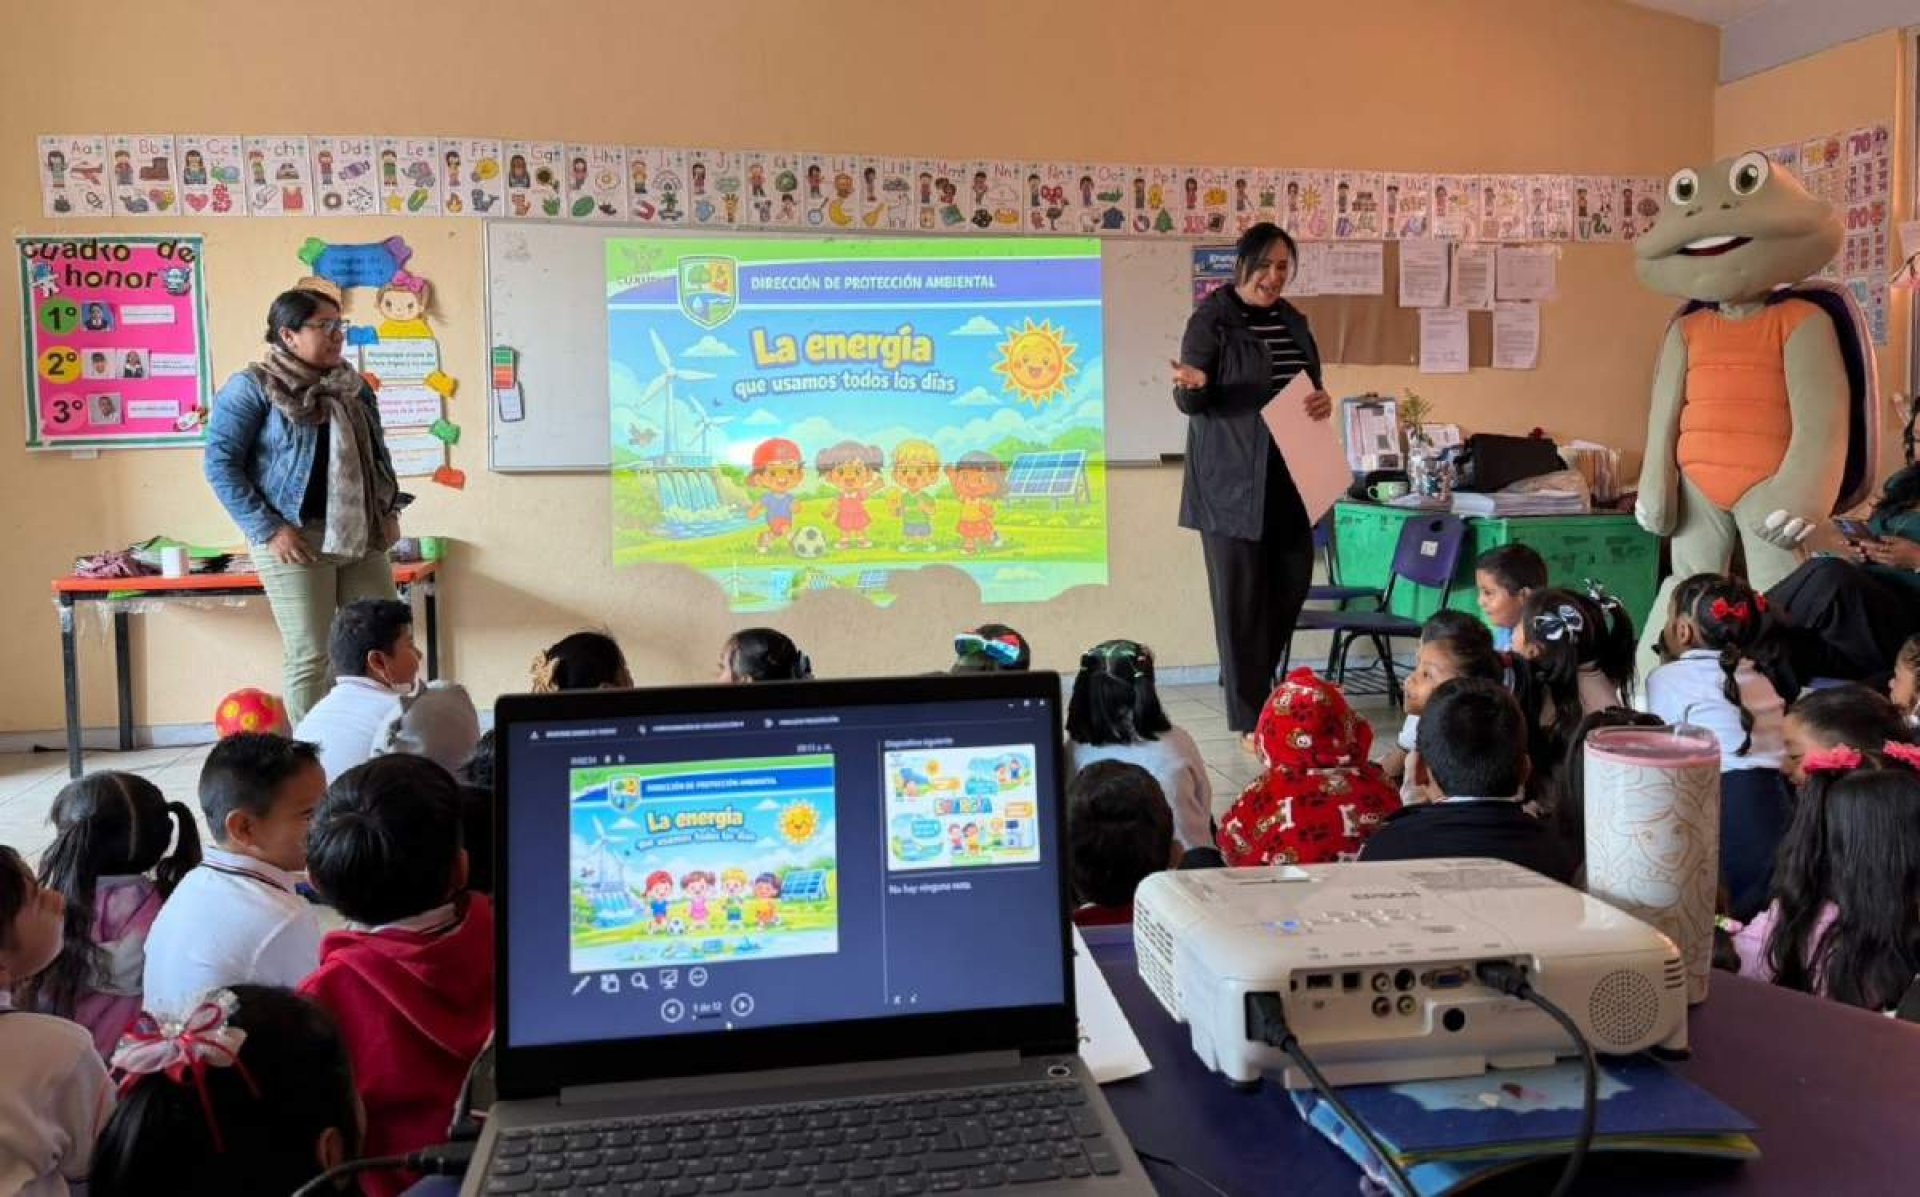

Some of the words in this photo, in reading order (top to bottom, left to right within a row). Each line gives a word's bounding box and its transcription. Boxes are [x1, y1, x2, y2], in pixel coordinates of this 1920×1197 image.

[71, 140, 92, 154] Aa
[138, 139, 158, 154] Bb
[206, 139, 230, 154] Cc
[340, 140, 361, 154] Dd
[1850, 132, 1872, 156] 70
[157, 239, 196, 263] de
[65, 264, 158, 289] honor
[750, 275, 820, 291] DIRECCIÓN
[823, 277, 841, 290] DE
[844, 275, 923, 290] PROTECCIÓN
[925, 276, 997, 289] AMBIENTAL
[751, 328, 798, 367] La
[805, 325, 934, 371] energía
[734, 378, 768, 399] que
[772, 375, 839, 393] usamos
[839, 371, 890, 390] todos
[893, 371, 917, 389] los
[920, 372, 956, 392] días
[646, 811, 671, 833] La
[675, 805, 744, 830] energía
